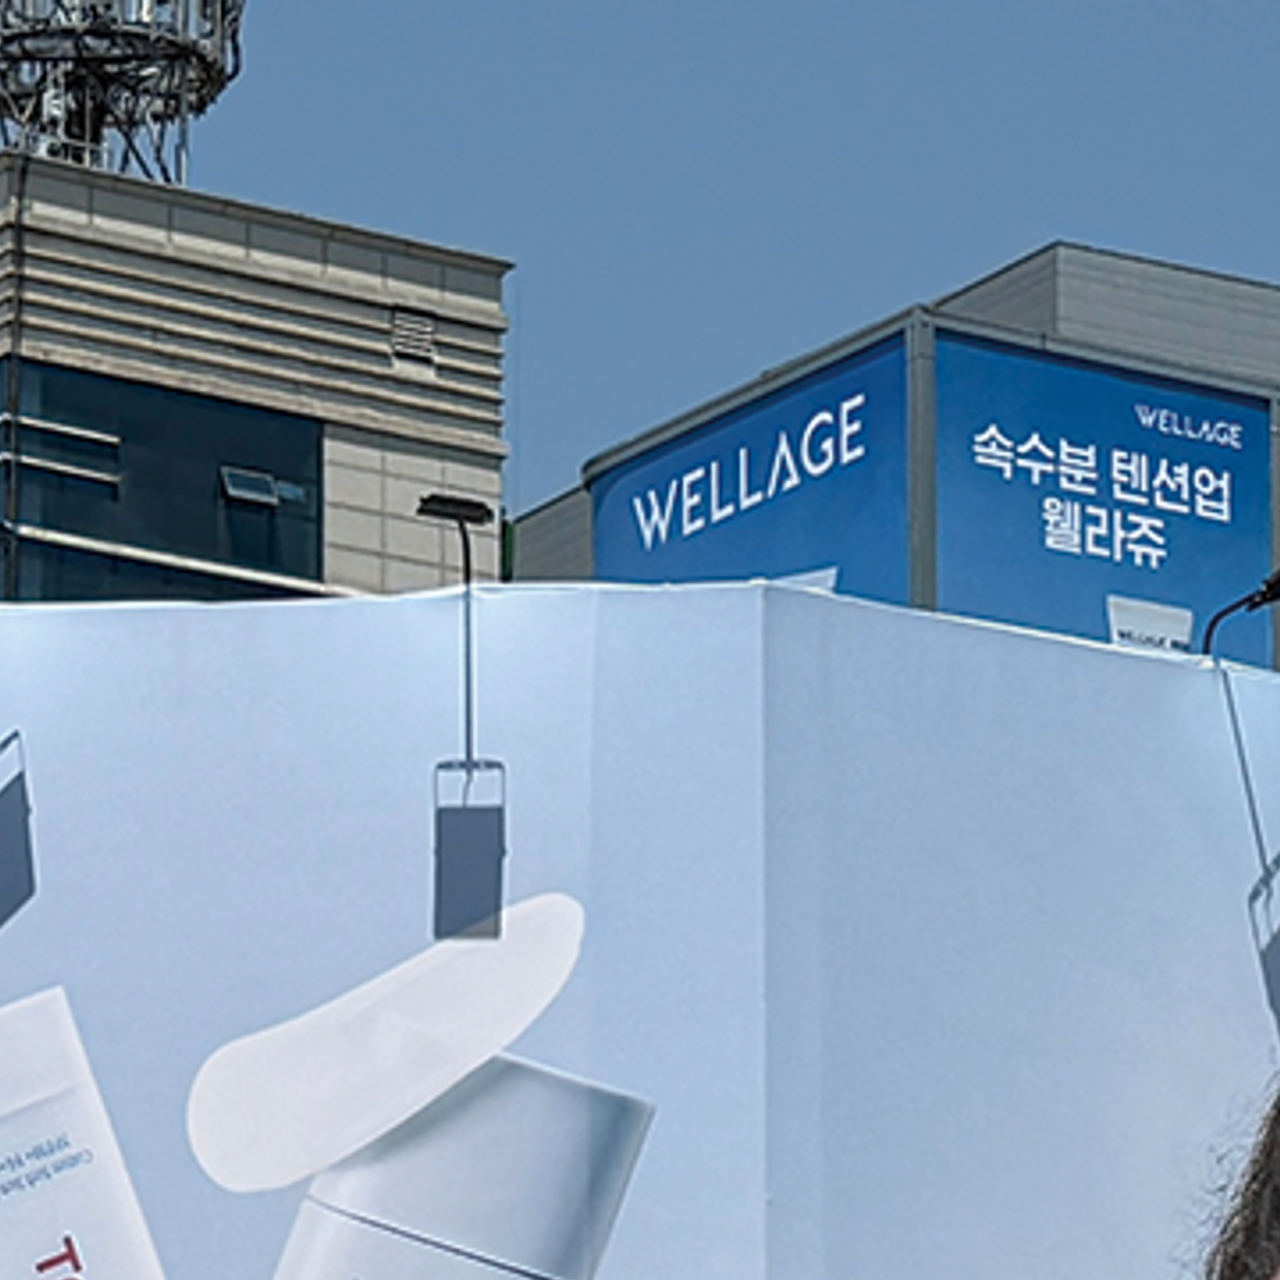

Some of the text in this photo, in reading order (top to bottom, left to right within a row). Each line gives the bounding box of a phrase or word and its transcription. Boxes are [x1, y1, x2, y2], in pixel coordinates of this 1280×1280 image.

[1135, 404, 1243, 450] WELLAGE
[633, 393, 866, 550] WELLAGE
[972, 423, 1232, 523] 속수분 텐션업
[1042, 497, 1168, 569] 웰라쥬
